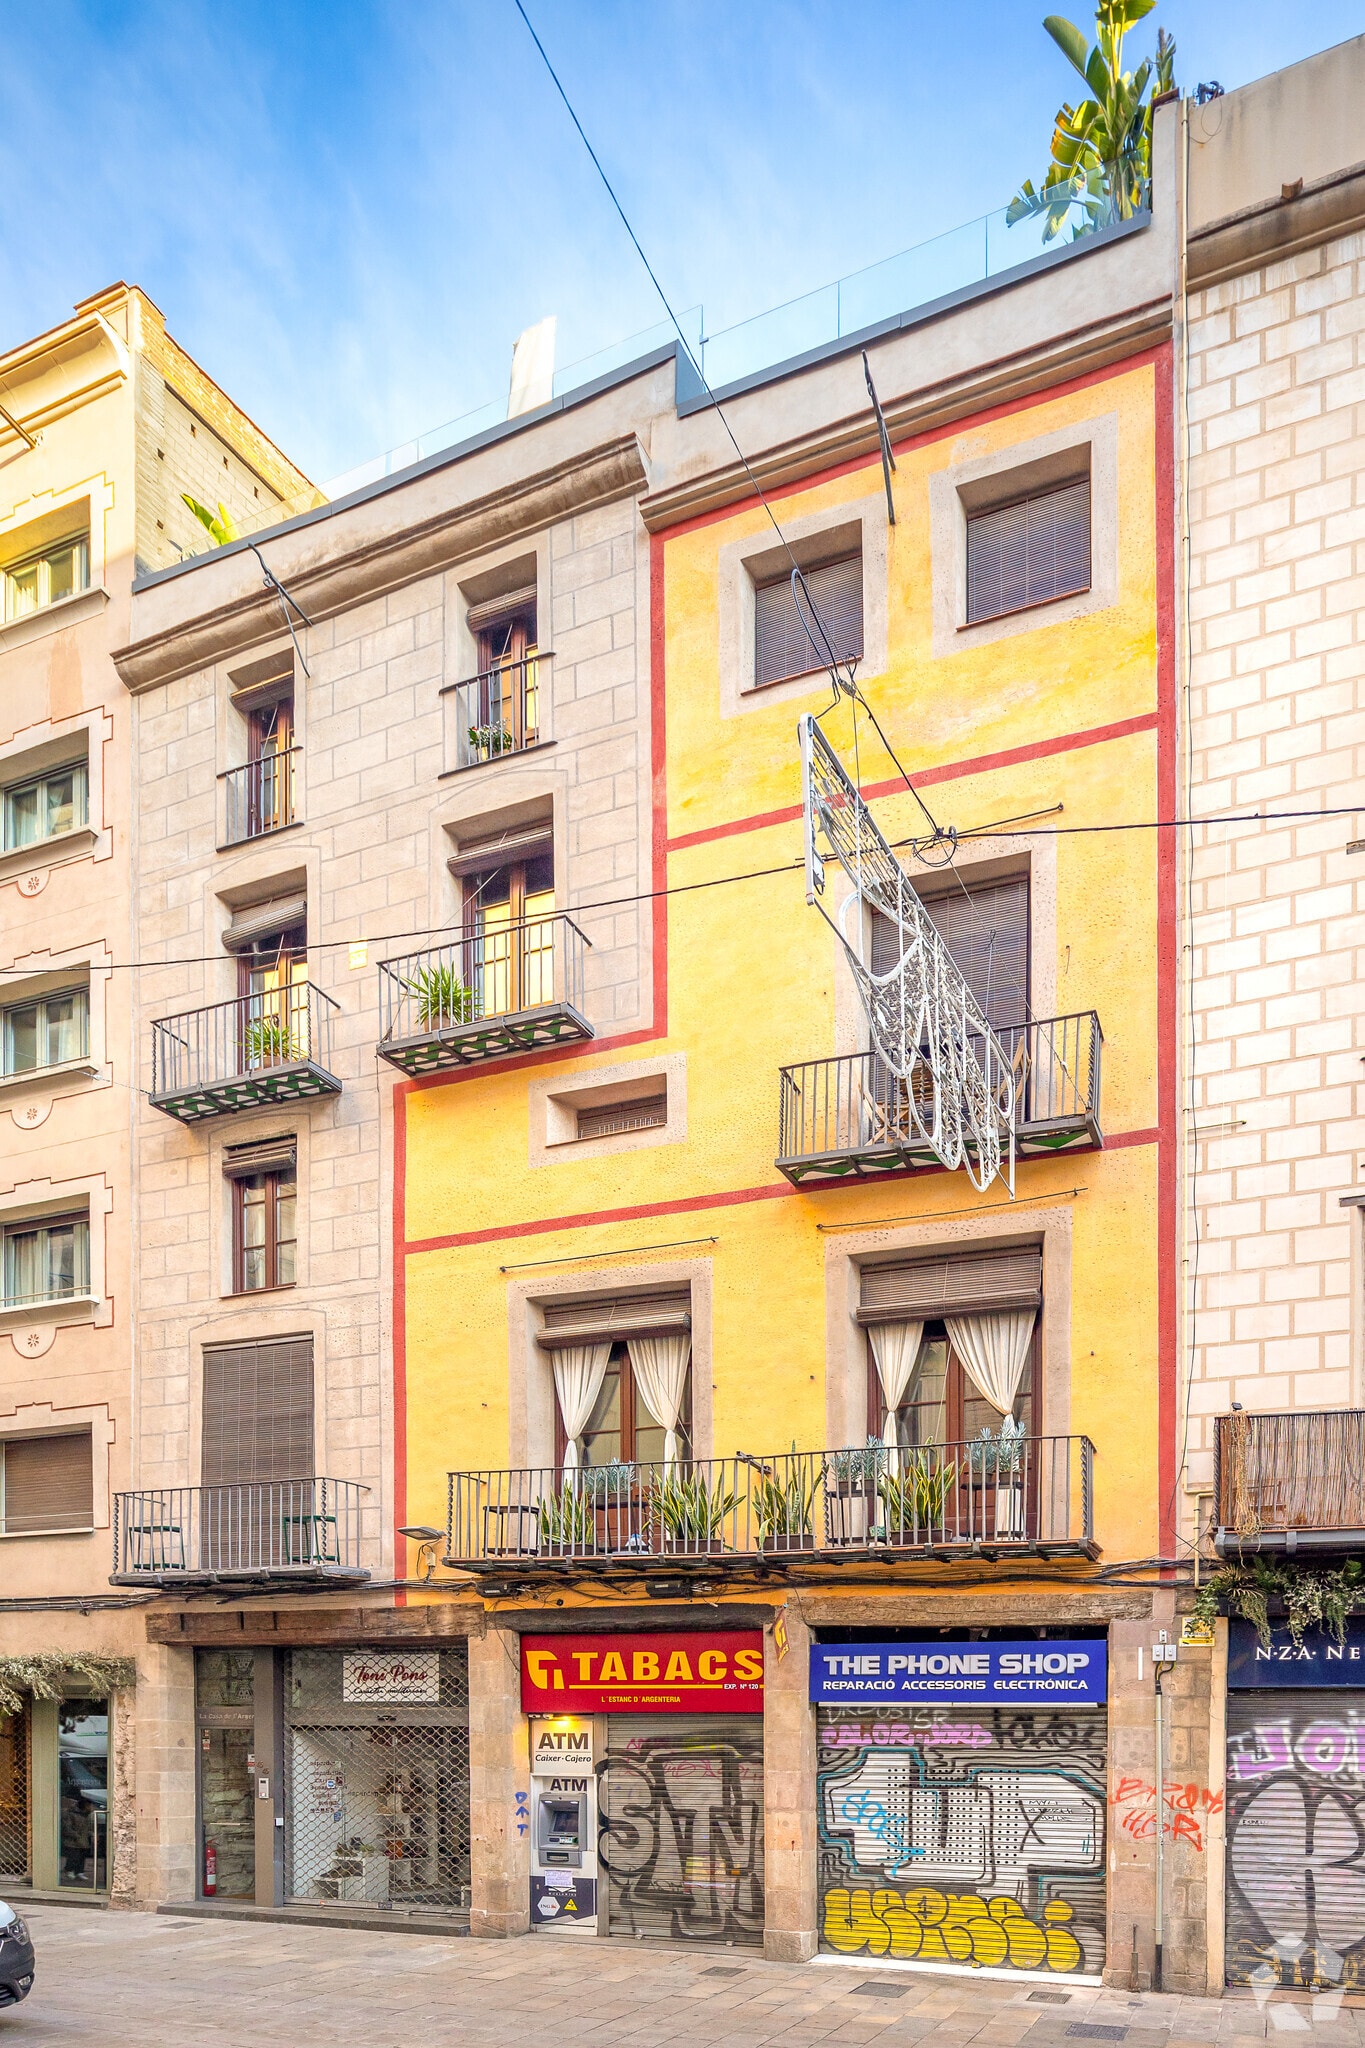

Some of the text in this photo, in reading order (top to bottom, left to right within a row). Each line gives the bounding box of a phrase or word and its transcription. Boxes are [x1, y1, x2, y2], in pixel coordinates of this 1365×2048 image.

[571, 1650, 764, 1681] TABACS
[823, 1653, 1090, 1675] THE PHONE SHOP
[823, 1678, 1089, 1691] REPARACIÓ ACCESSORIS ELECTRÓNICA
[538, 1733, 589, 1750] ATM
[549, 1779, 588, 1792] ATM
